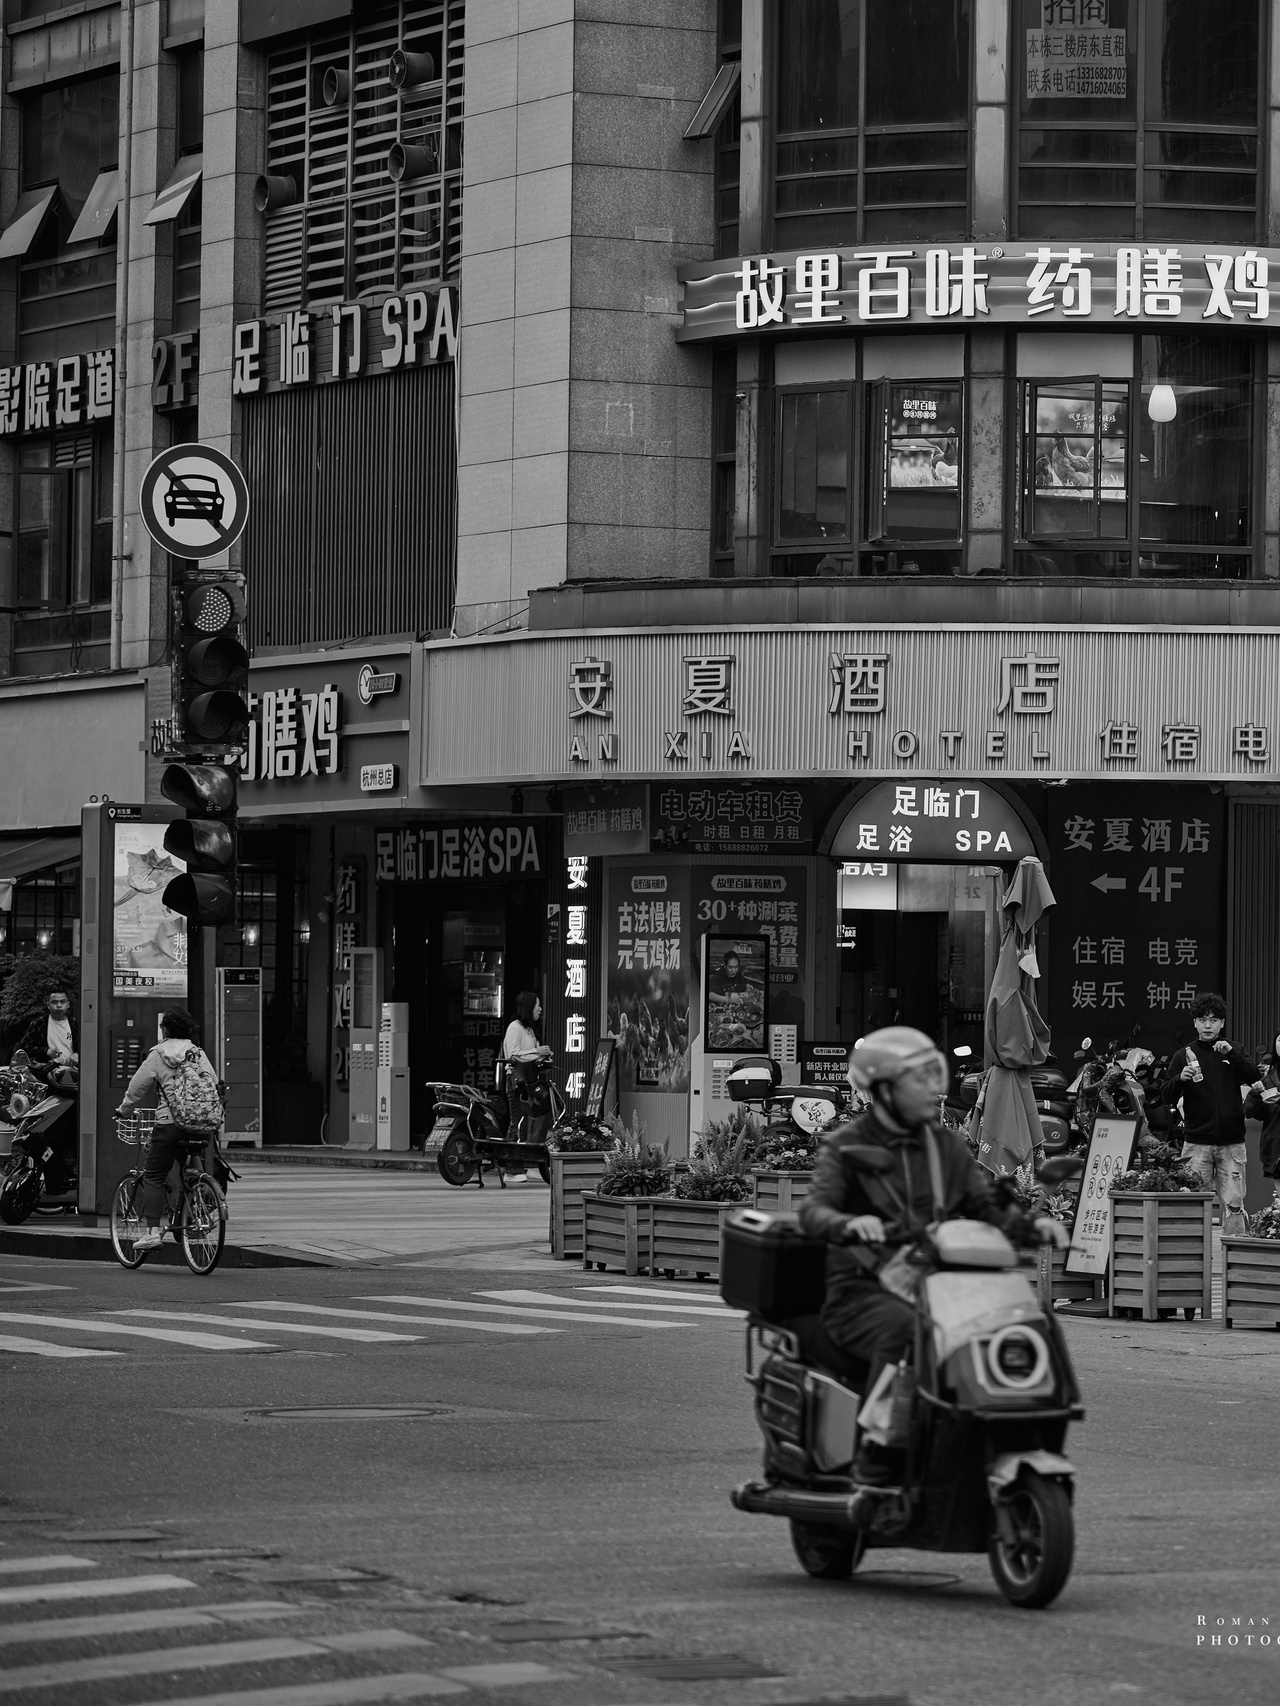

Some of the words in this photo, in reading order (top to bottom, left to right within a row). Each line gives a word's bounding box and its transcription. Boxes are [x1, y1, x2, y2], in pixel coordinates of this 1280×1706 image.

[1028, 34, 1125, 58] 本栋三楼房东直租
[1028, 68, 1076, 93] 联系电话
[1077, 67, 1126, 80] 13316828707
[1077, 82, 1126, 95] 14716024065
[734, 247, 990, 329] 故里百味
[1025, 247, 1270, 320] 药膳鸡
[234, 304, 367, 394] 足临门
[382, 286, 457, 369] SPA
[151, 333, 197, 405] 2F
[568, 734, 618, 762] AN
[664, 731, 752, 760] XIA
[848, 731, 1050, 760] HOTEL
[362, 768, 392, 787] 杭州总店
[660, 789, 803, 823] 电动车租赁
[892, 786, 980, 819] 足临门
[703, 825, 731, 840] 时租
[740, 825, 766, 840] 日租
[773, 825, 800, 840] 月租
[856, 823, 914, 853] 足浴
[955, 829, 1013, 852] SPA
[1063, 814, 1211, 854] 安夏酒店
[1138, 866, 1185, 903] 4F
[617, 901, 681, 934] 古法慢煨
[758, 924, 799, 947] 免费
[617, 938, 681, 970] 元气鸡汤
[1072, 936, 1126, 966] 住宿
[1149, 937, 1199, 967] 电竞
[1072, 980, 1126, 1010] 娱乐
[1146, 980, 1198, 1010] 钟点
